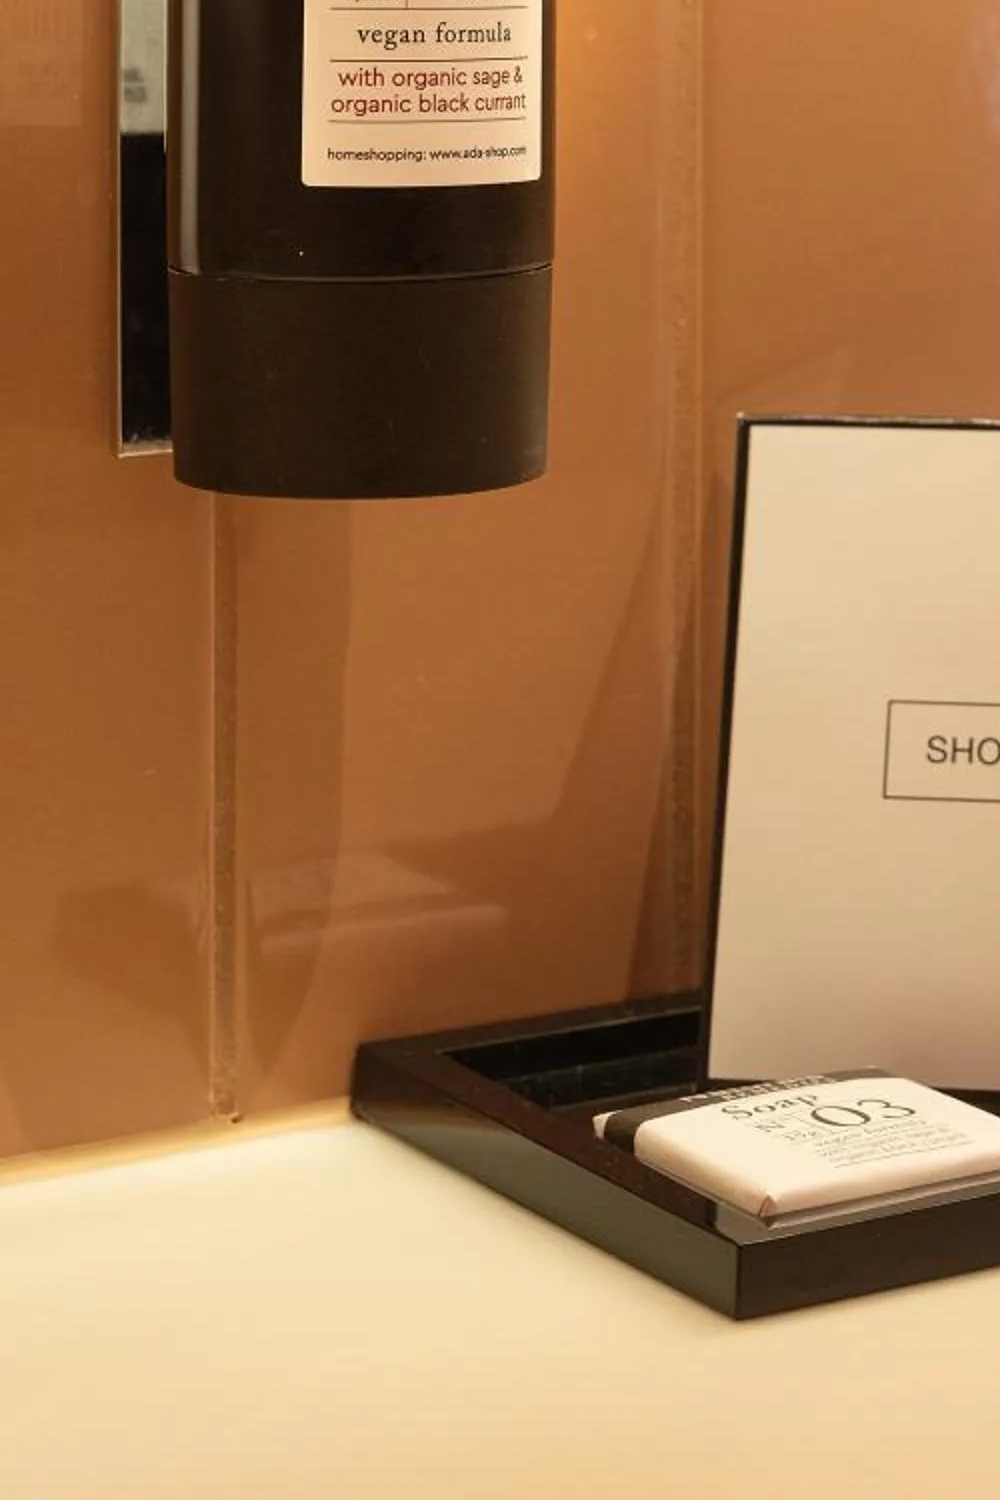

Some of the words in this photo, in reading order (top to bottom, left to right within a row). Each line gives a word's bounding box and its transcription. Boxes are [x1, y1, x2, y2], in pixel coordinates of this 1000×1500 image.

[357, 27, 426, 51] vegan
[435, 21, 512, 44] formula
[338, 67, 385, 88] with
[391, 66, 468, 91] organic
[472, 69, 511, 89] sage
[513, 65, 523, 84] &
[331, 94, 412, 117] organic
[418, 92, 470, 113] black
[474, 94, 527, 112] currant
[327, 147, 428, 163] homeshopping:
[721, 1094, 818, 1121] Soap
[811, 1099, 917, 1127] 03
